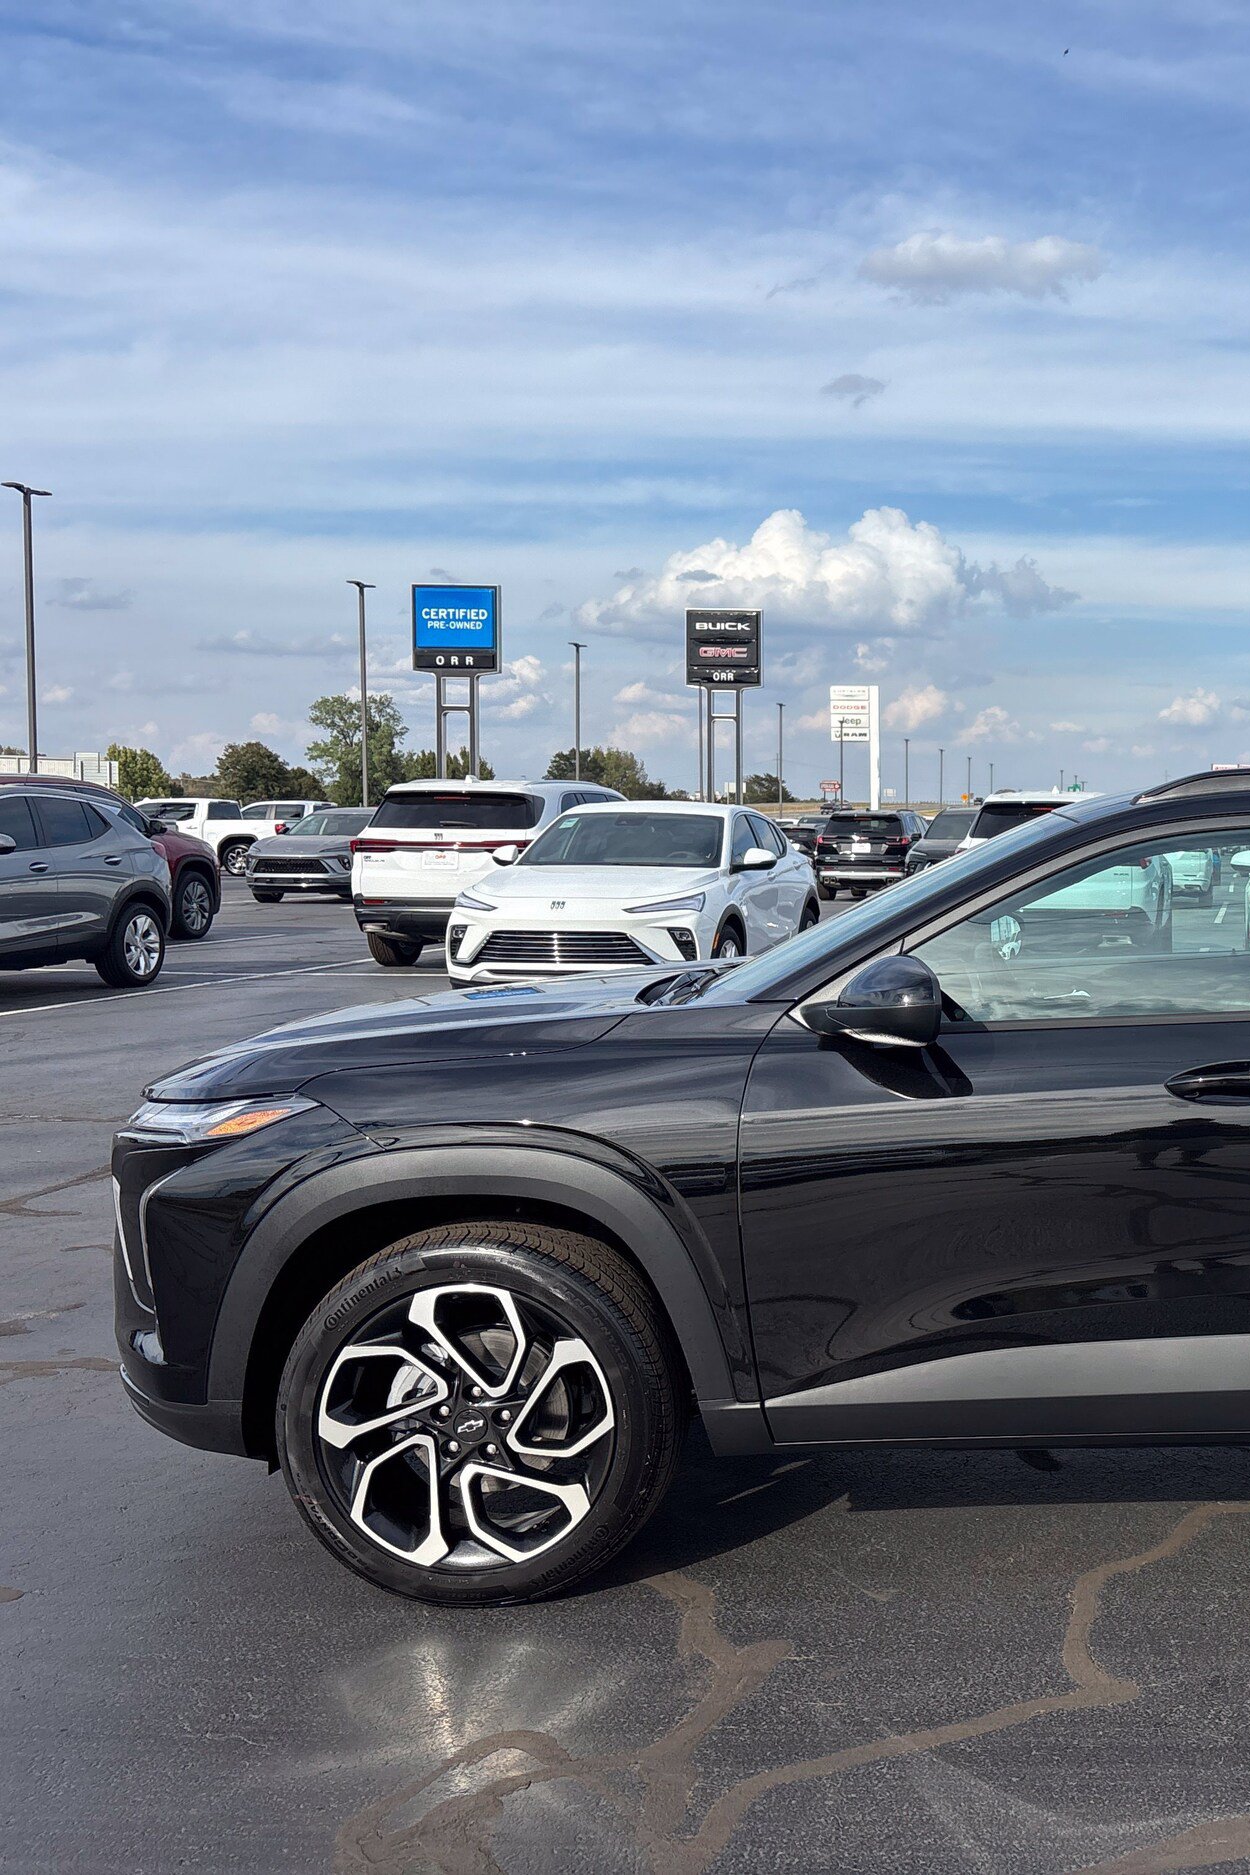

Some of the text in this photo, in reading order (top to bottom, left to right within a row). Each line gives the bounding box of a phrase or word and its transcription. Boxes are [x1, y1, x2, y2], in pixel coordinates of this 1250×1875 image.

[421, 608, 488, 620] CERTIFIED
[427, 621, 483, 630] PRE-OWNED
[695, 622, 751, 630] BUICK
[699, 646, 748, 658] GMC
[712, 672, 734, 681] ORR
[323, 1270, 393, 1331] Continental
